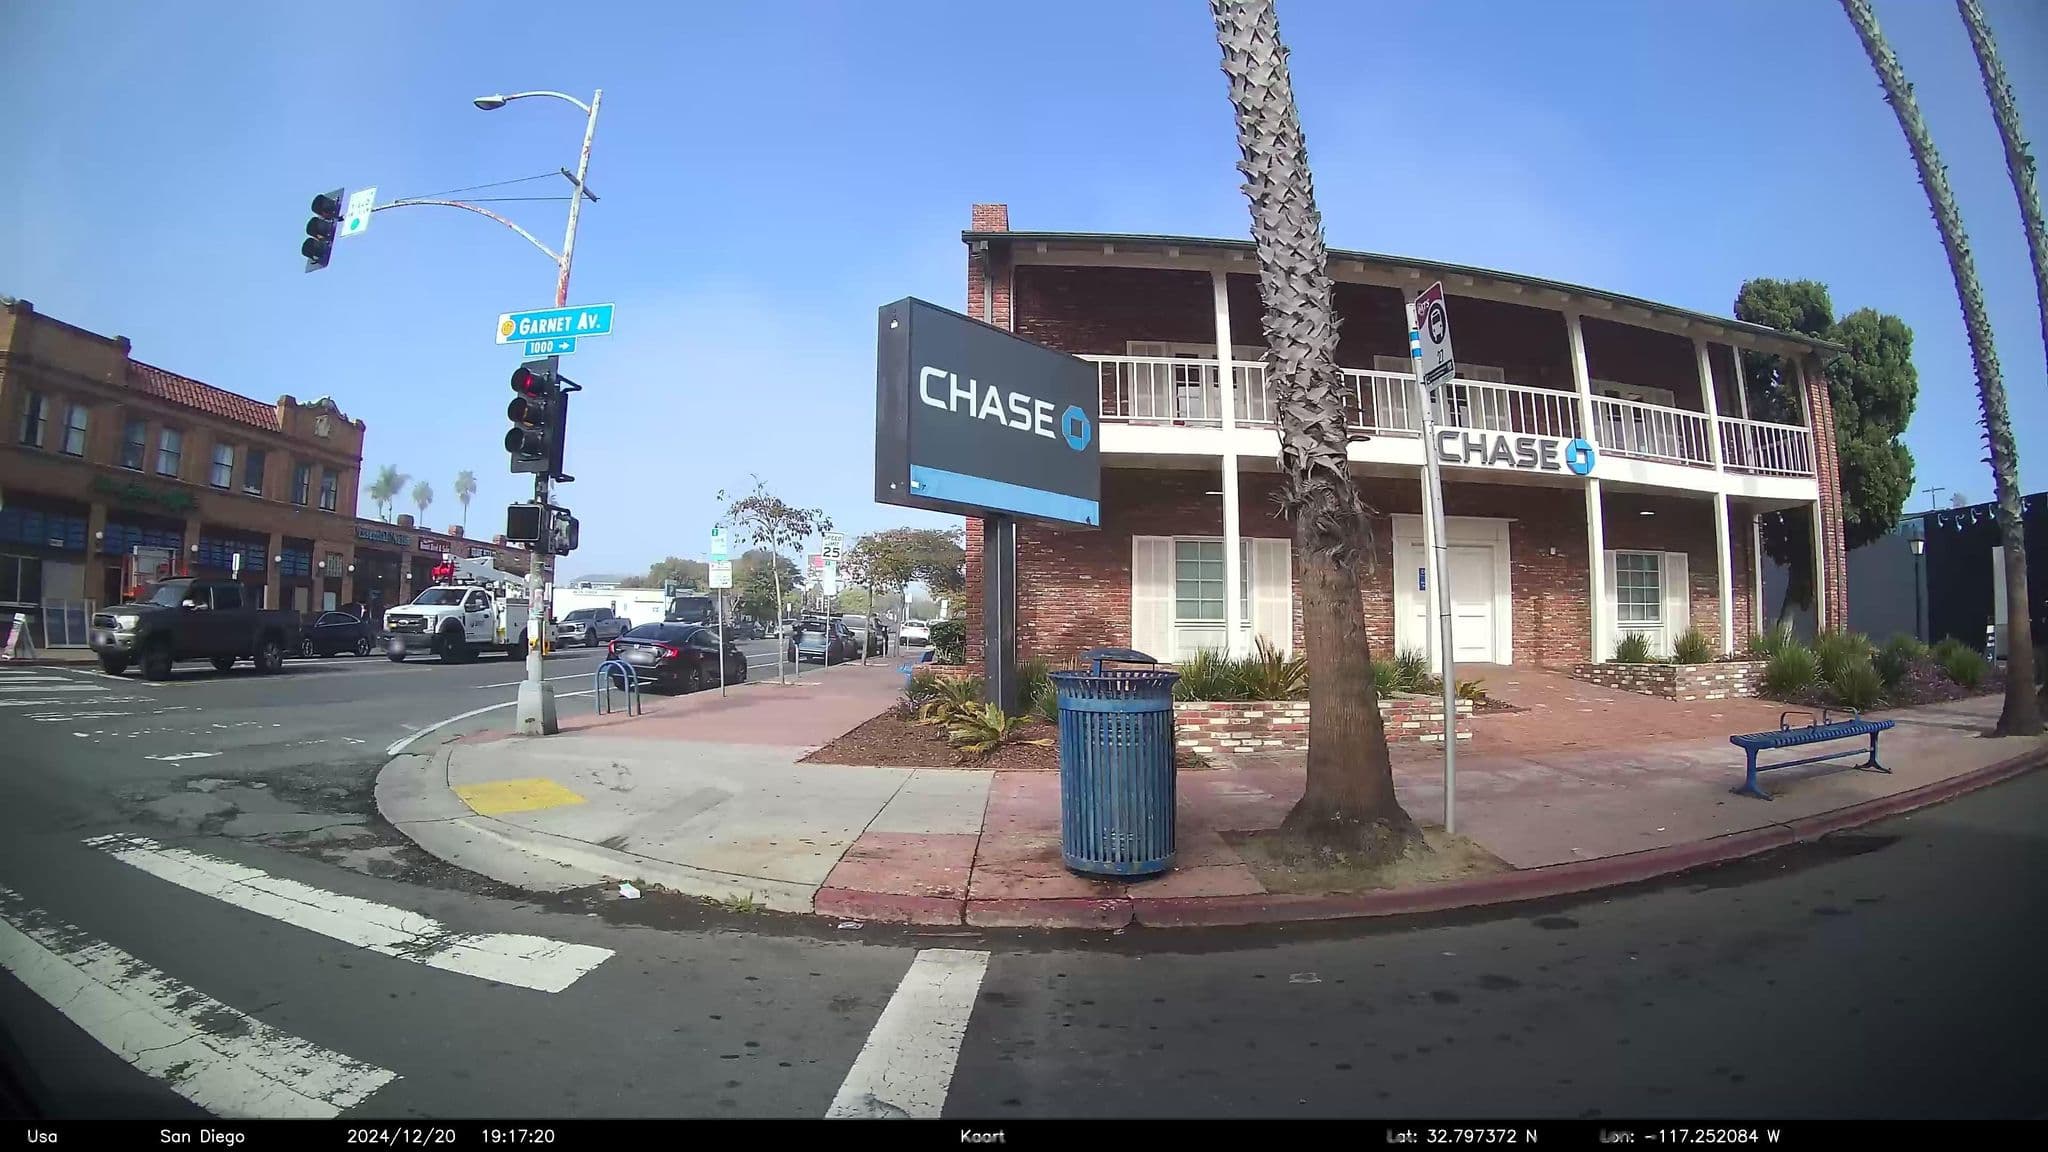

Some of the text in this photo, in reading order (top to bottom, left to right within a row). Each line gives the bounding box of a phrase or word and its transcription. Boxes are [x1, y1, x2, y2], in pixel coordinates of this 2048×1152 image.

[520, 312, 600, 335] GARNET AV.
[530, 341, 553, 354] 1000
[919, 365, 1056, 439] CHASE
[1437, 430, 1561, 471] CHASE
[823, 547, 840, 557] 25
